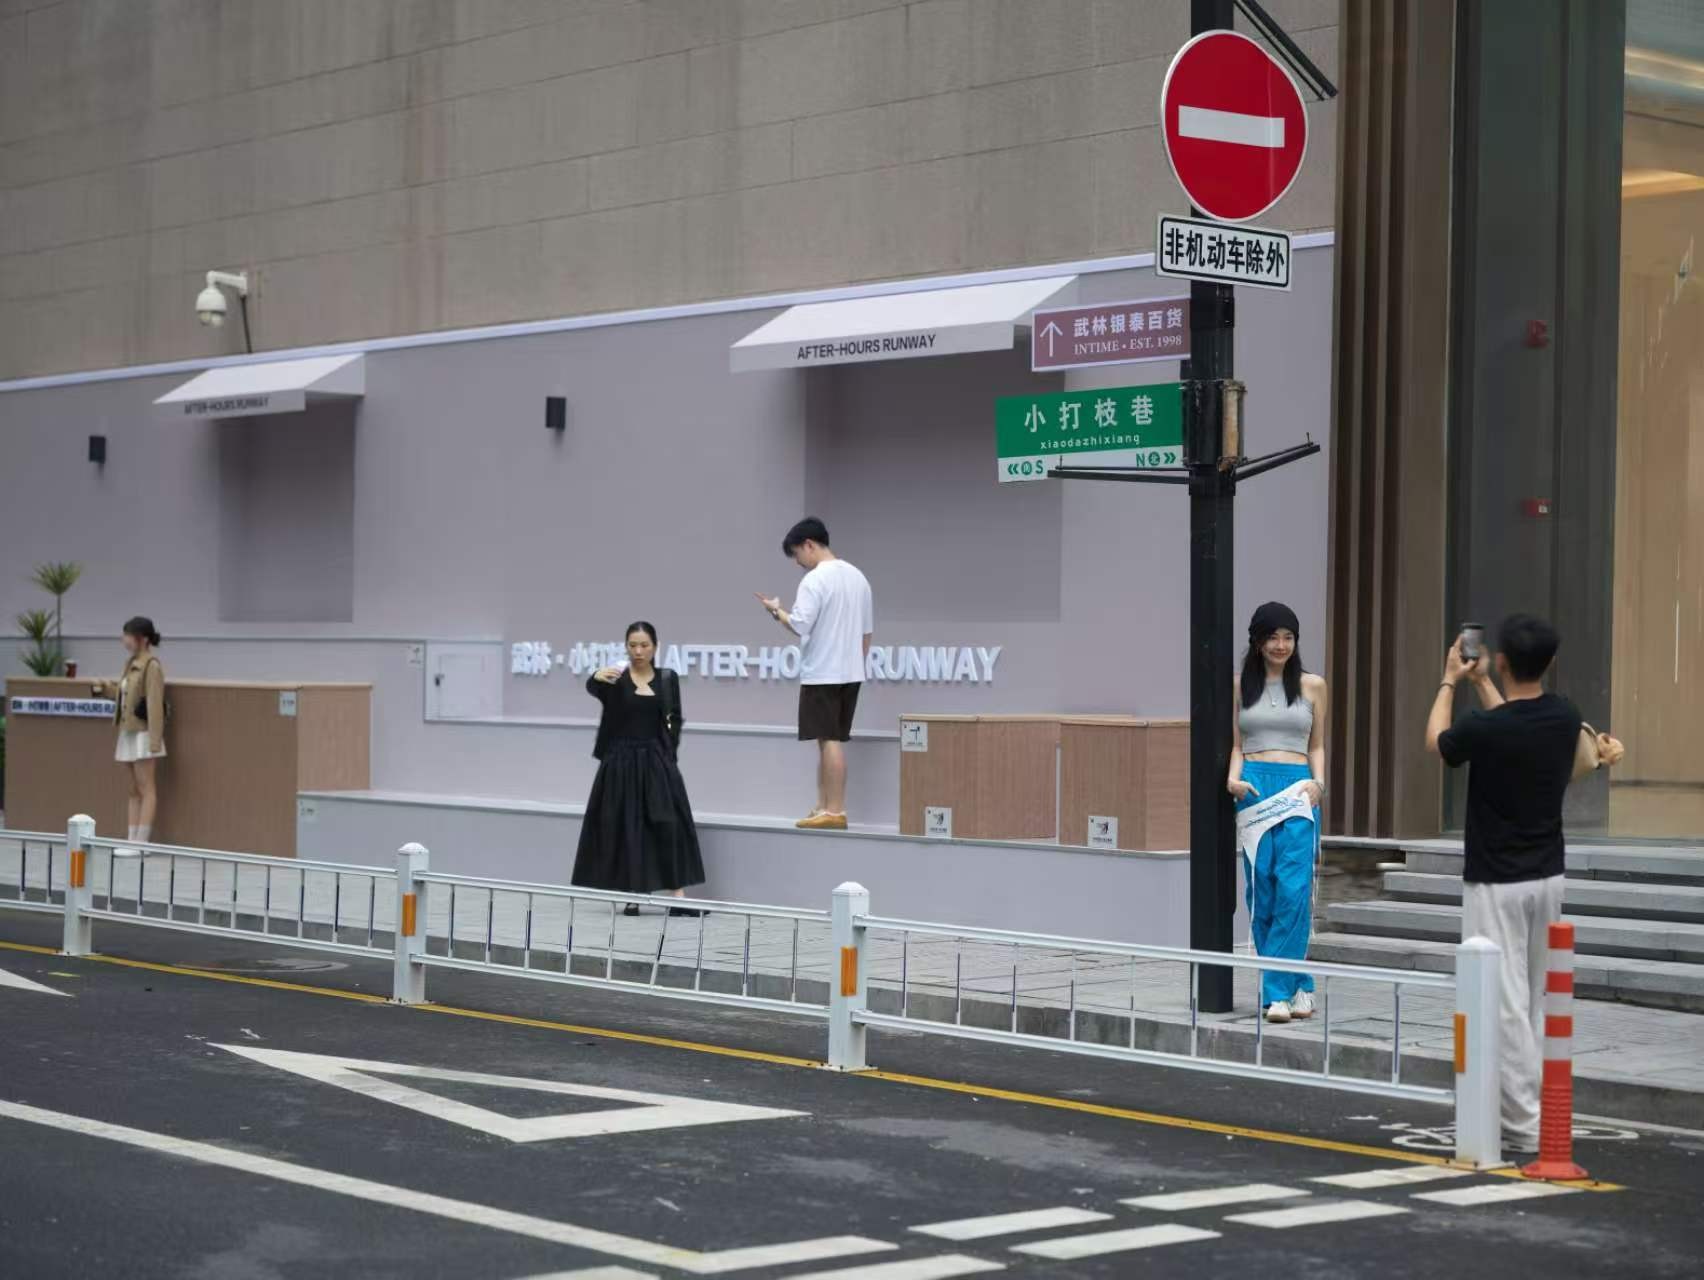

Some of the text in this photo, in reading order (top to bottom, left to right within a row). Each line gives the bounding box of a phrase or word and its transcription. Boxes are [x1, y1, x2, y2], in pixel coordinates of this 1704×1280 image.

[1164, 227, 1285, 277] 非机动车除外
[1073, 307, 1184, 338] 武林银泰百货
[797, 334, 936, 360] AFTER-HOURS RUNWAY
[1074, 334, 1182, 355] INTIME EST. 1998
[1024, 395, 1155, 433] 小打枝巷
[1040, 433, 1140, 450] xiaodazhixiang
[663, 644, 1001, 681] AFTER-HO RUNWAY
